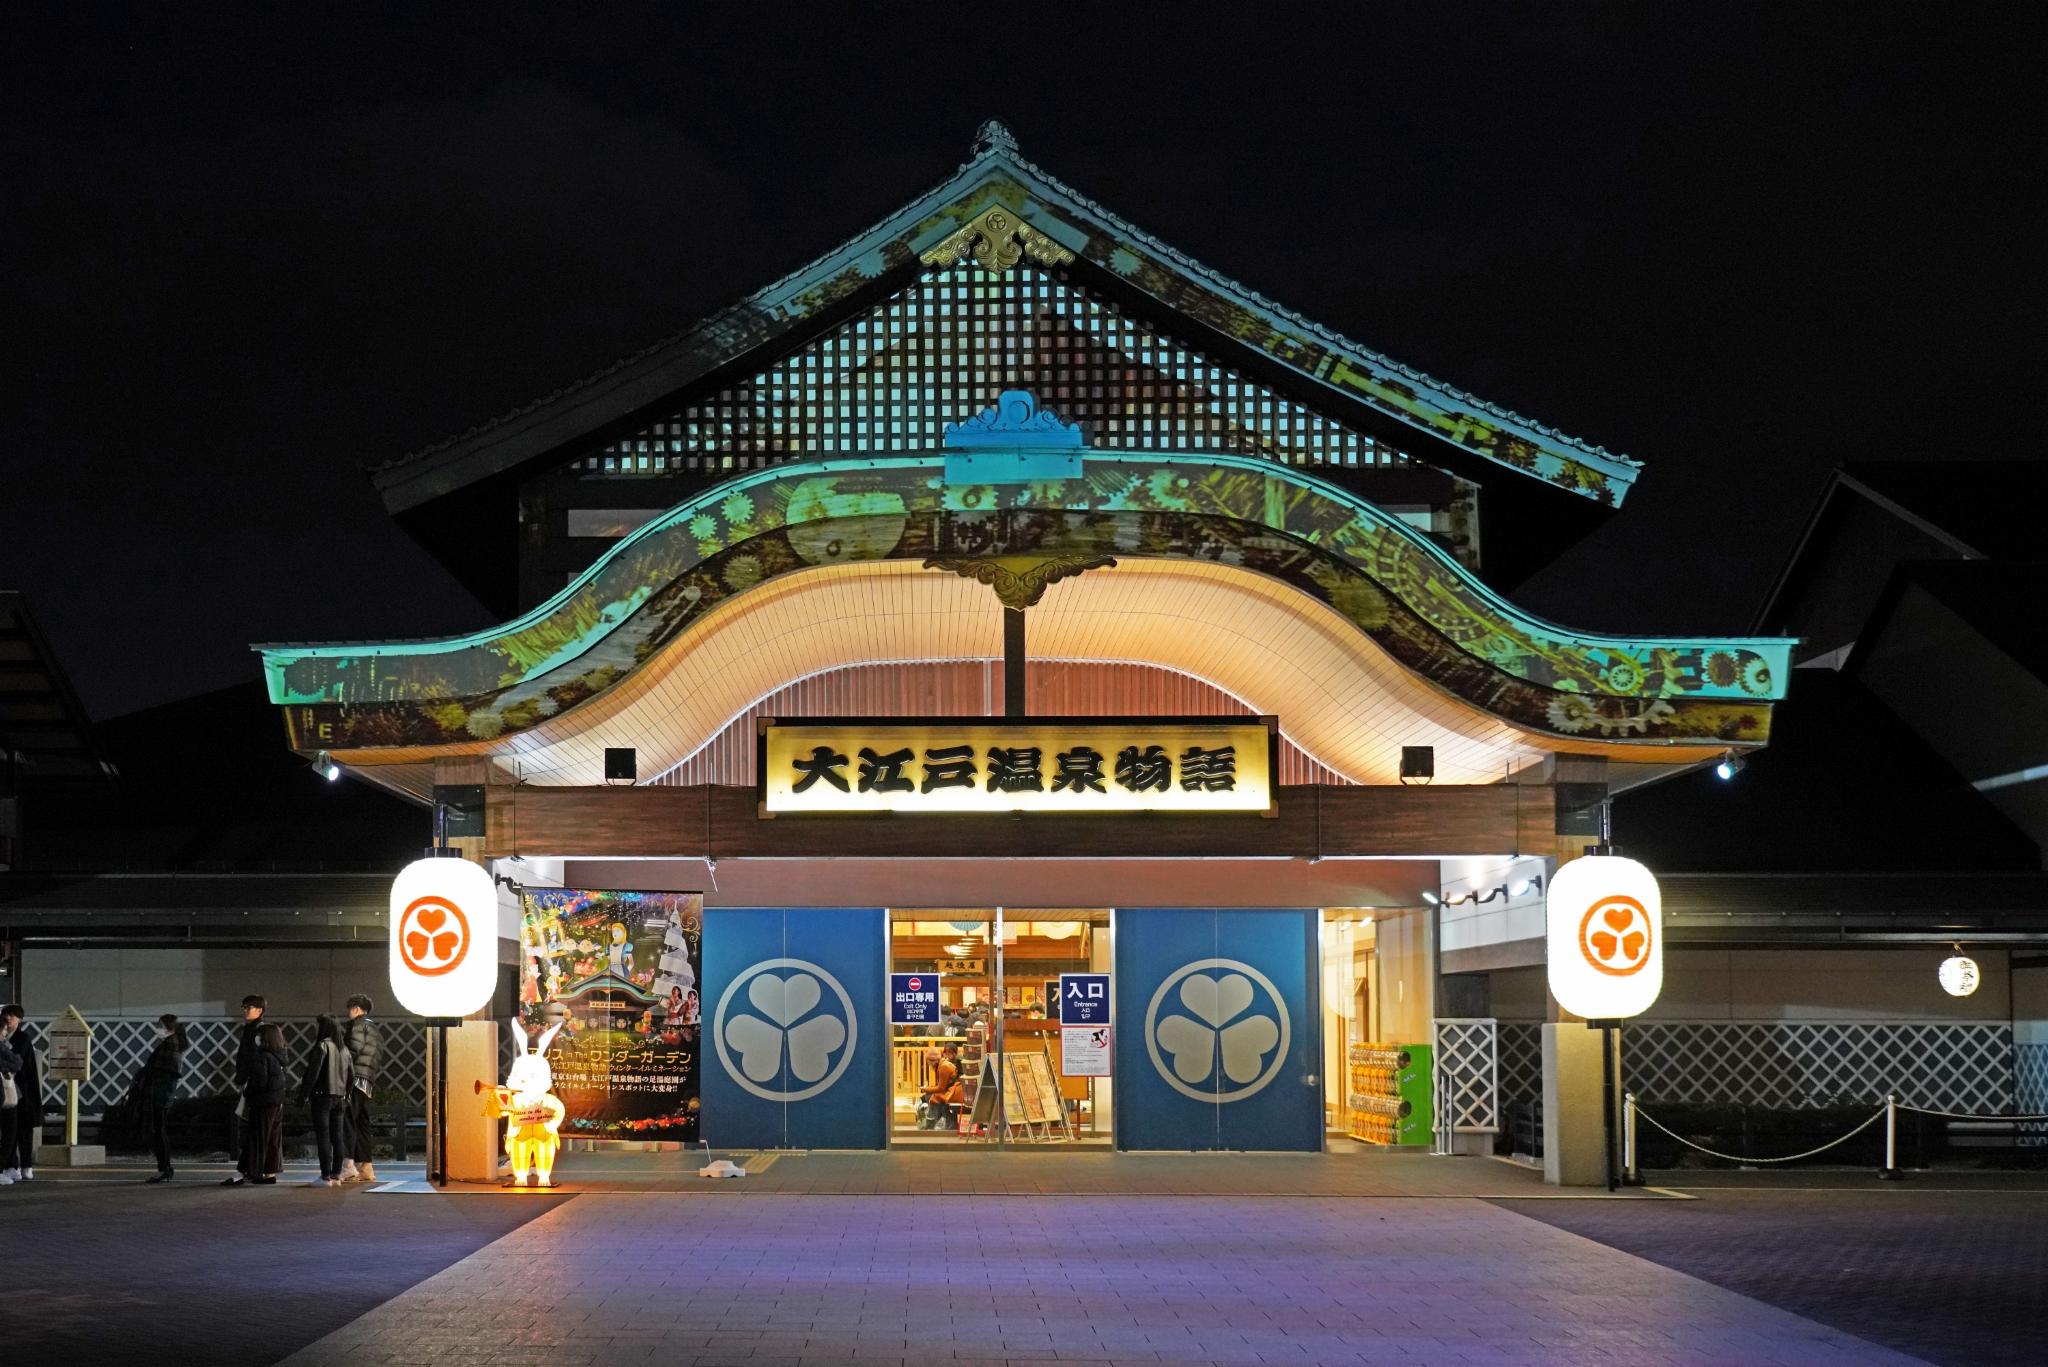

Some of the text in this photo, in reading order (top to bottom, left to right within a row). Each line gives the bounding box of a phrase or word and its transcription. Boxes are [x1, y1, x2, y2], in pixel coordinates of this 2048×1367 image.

[791, 745, 1237, 795] 大江戸温泉物語
[895, 992, 935, 1003] 出口専用
[1066, 982, 1104, 999] 入口
[914, 1002, 927, 1011] Only
[590, 1050, 692, 1065] ワンダーガーデン
